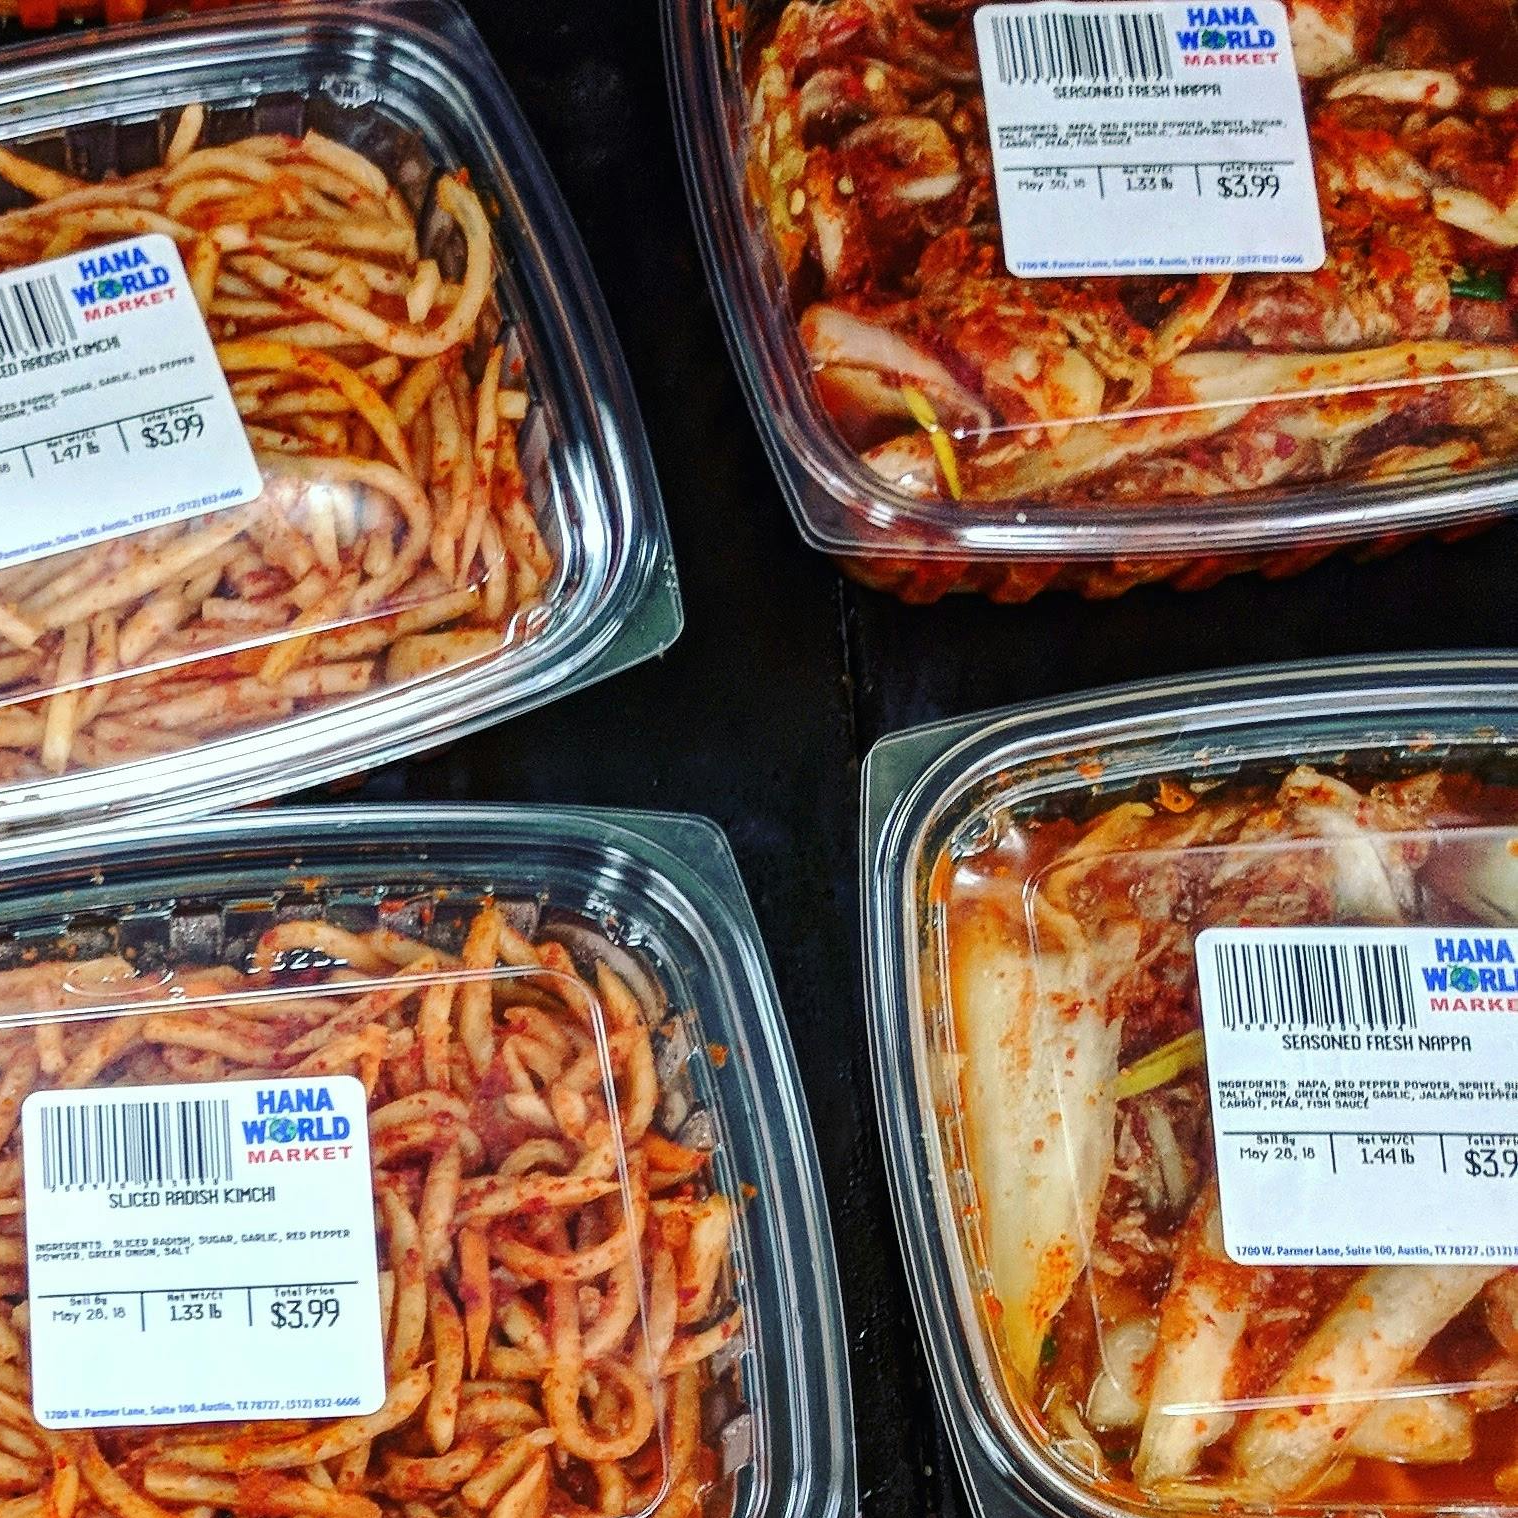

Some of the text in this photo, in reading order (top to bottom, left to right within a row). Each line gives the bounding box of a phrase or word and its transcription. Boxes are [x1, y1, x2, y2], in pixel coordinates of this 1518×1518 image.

[1186, 6, 1259, 27] HANA
[1176, 28, 1275, 51] WORLD
[1183, 52, 1278, 66] MARKET
[77, 247, 149, 281] HANA
[71, 265, 170, 307] WORLD
[83, 287, 175, 322] MARKET
[1434, 937, 1515, 963] HANA
[1421, 965, 1518, 993] WORL
[1430, 997, 1518, 1013] MARKE
[1281, 1033, 1472, 1052] SEASONED FRESH NAPPA
[256, 1087, 335, 1115] HANA
[241, 1115, 351, 1145] WORLD
[247, 1145, 353, 1164] MARKET
[1239, 1147, 1269, 1162] May
[1301, 1147, 1316, 1160] 18
[1361, 1148, 1415, 1165] 1.44 lb
[1463, 1148, 1518, 1179] $3.9
[108, 1185, 276, 1209] SLICED RADISH KIMCHI
[1235, 1245, 1261, 1257] 1700
[1276, 1244, 1314, 1257] Parmer
[1344, 1244, 1372, 1257] Suite
[1433, 1244, 1447, 1256] TX
[52, 1310, 81, 1323] May
[112, 1306, 126, 1319] 18
[170, 1302, 222, 1322] 1.33 lb
[270, 1298, 340, 1329] $3.99
